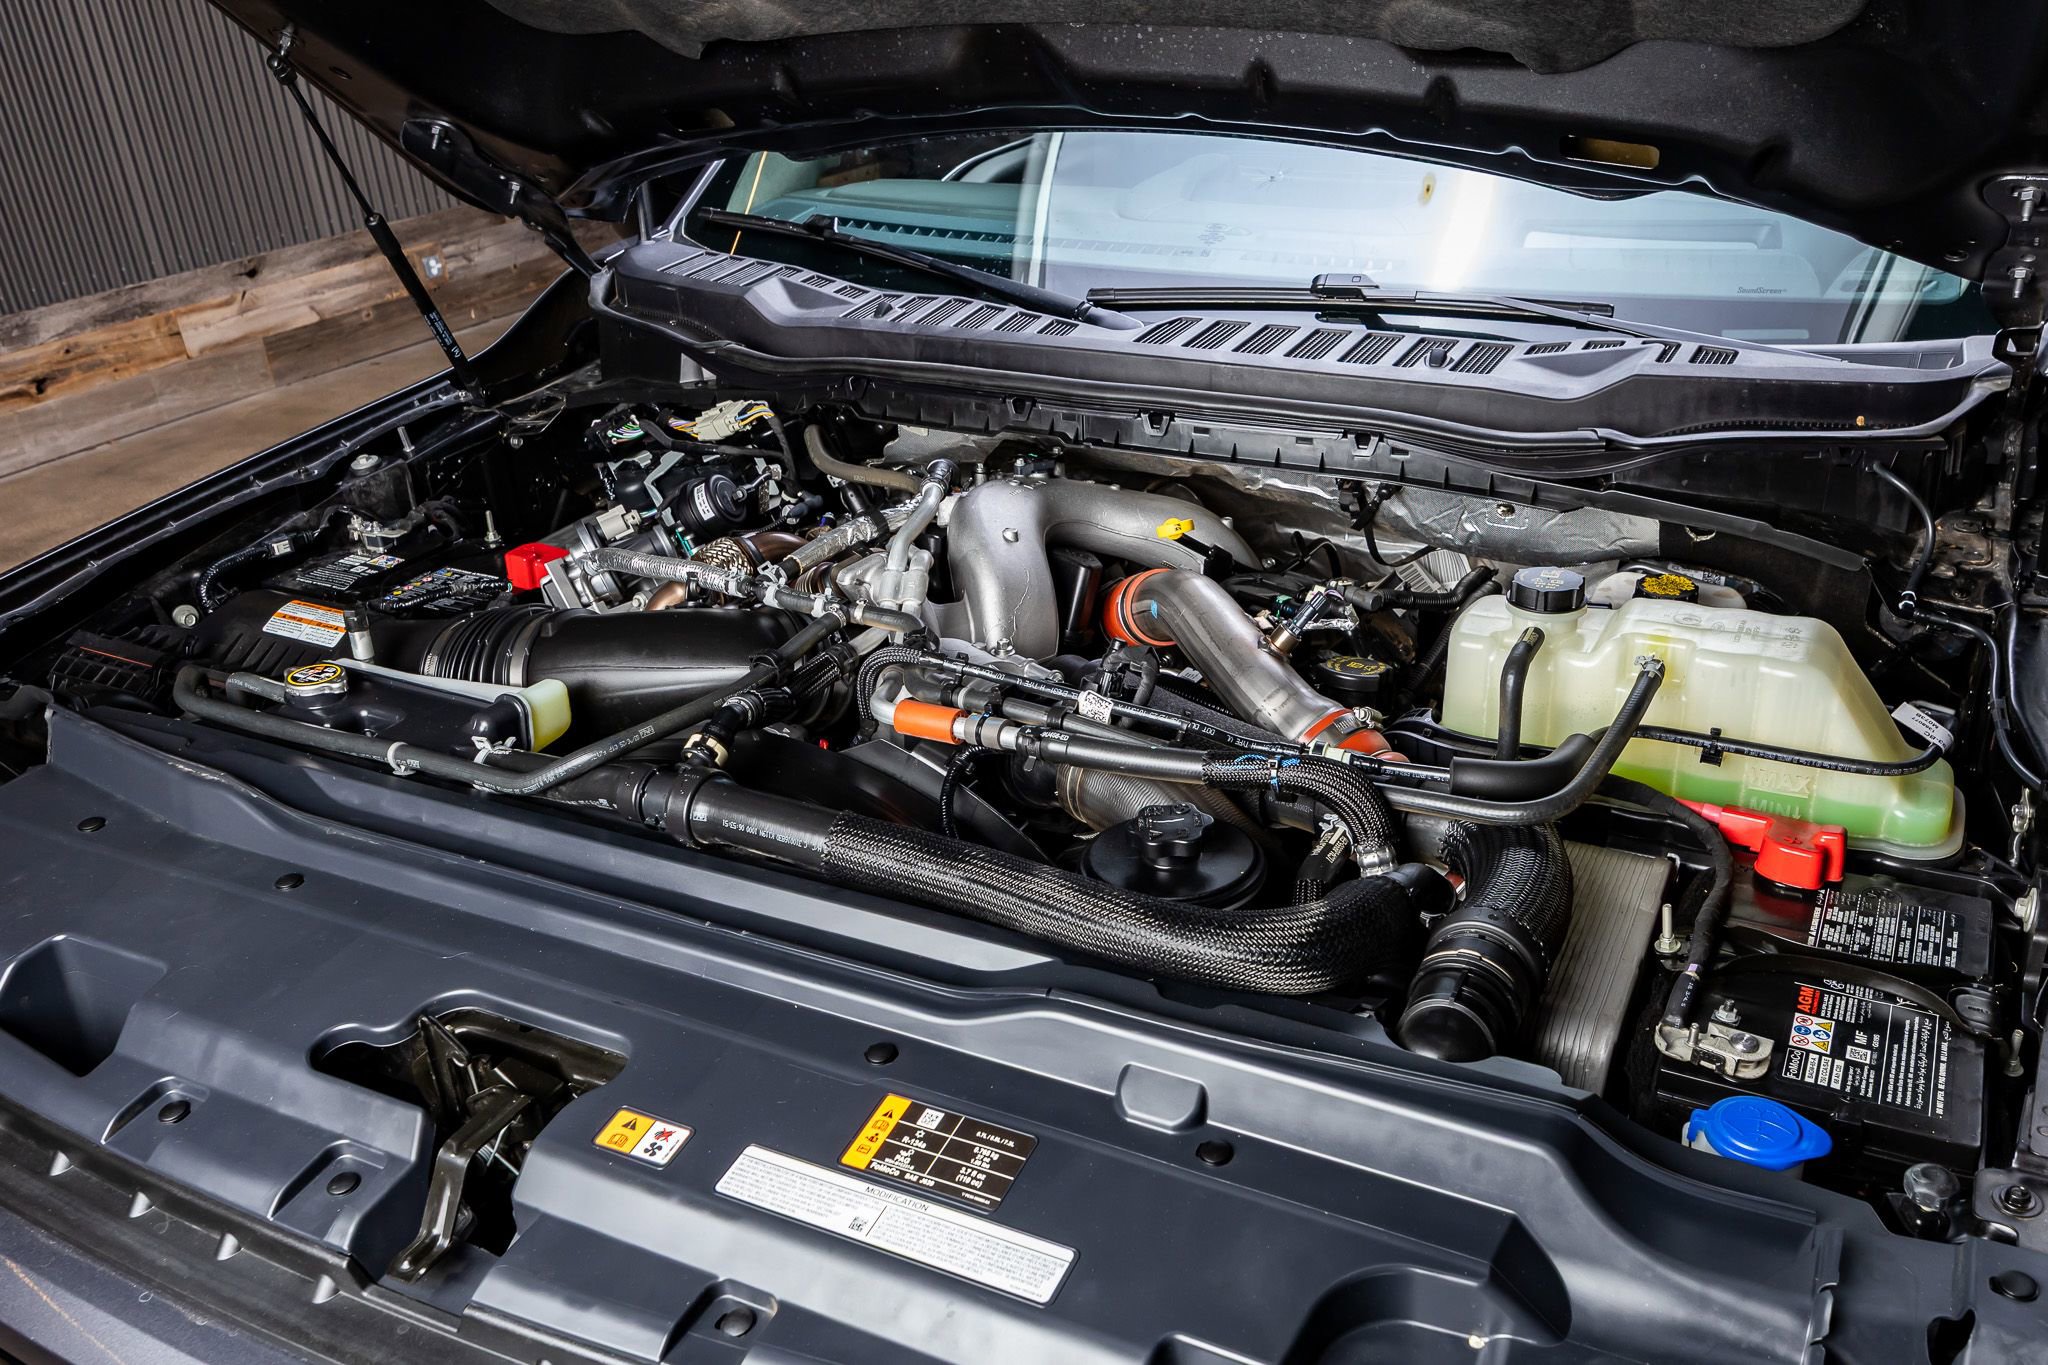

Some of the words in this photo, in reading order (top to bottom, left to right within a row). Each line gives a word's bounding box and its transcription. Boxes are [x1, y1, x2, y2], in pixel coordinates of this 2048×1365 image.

[1798, 986, 1815, 1013] AGM
[1854, 1030, 1868, 1045] MF
[1787, 1050, 1801, 1079] FoMoCo
[901, 1136, 927, 1148] R-134a
[894, 1154, 911, 1163] PAG
[869, 1162, 900, 1176] FoMoCo
[865, 1186, 930, 1212] MODIFICATION
